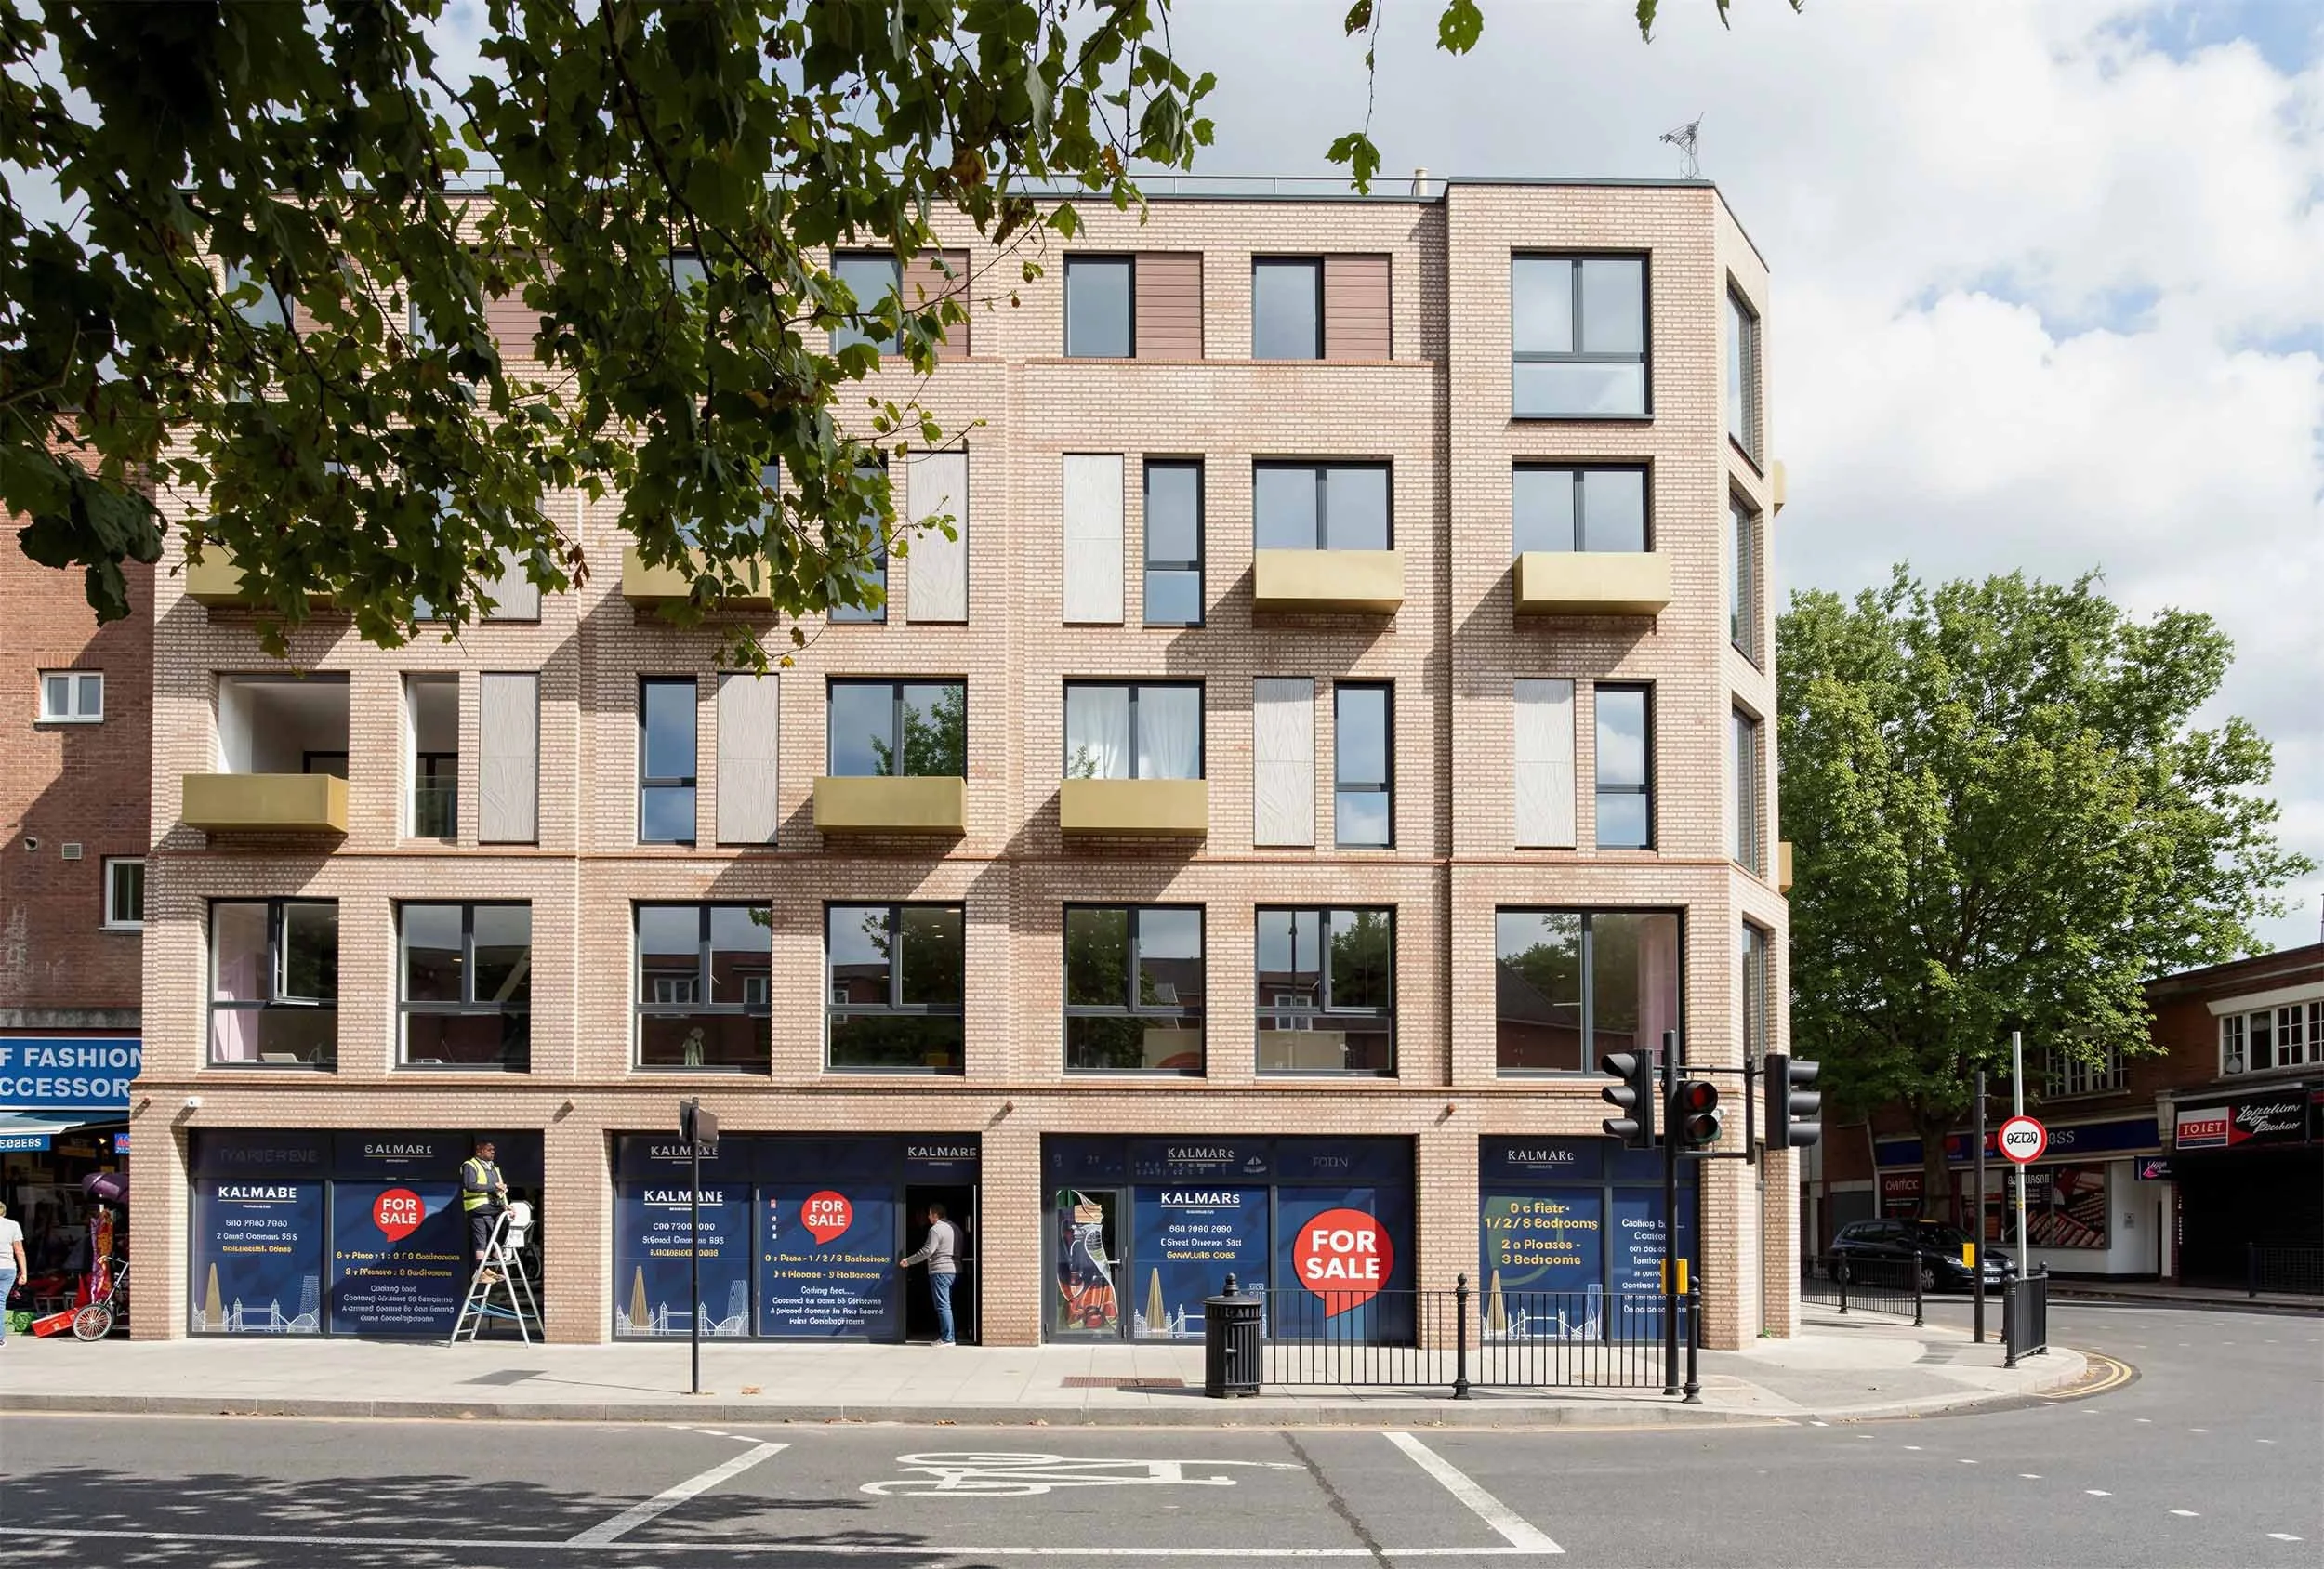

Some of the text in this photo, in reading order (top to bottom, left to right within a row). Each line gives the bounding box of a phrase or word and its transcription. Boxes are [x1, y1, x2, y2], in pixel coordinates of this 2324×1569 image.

[382, 1198, 416, 1211] FOR
[812, 1200, 844, 1213] FOR
[380, 1212, 417, 1225] SALE
[808, 1214, 846, 1226] SALE
[1312, 1229, 1377, 1253] FOR
[1305, 1257, 1380, 1280] SALE
